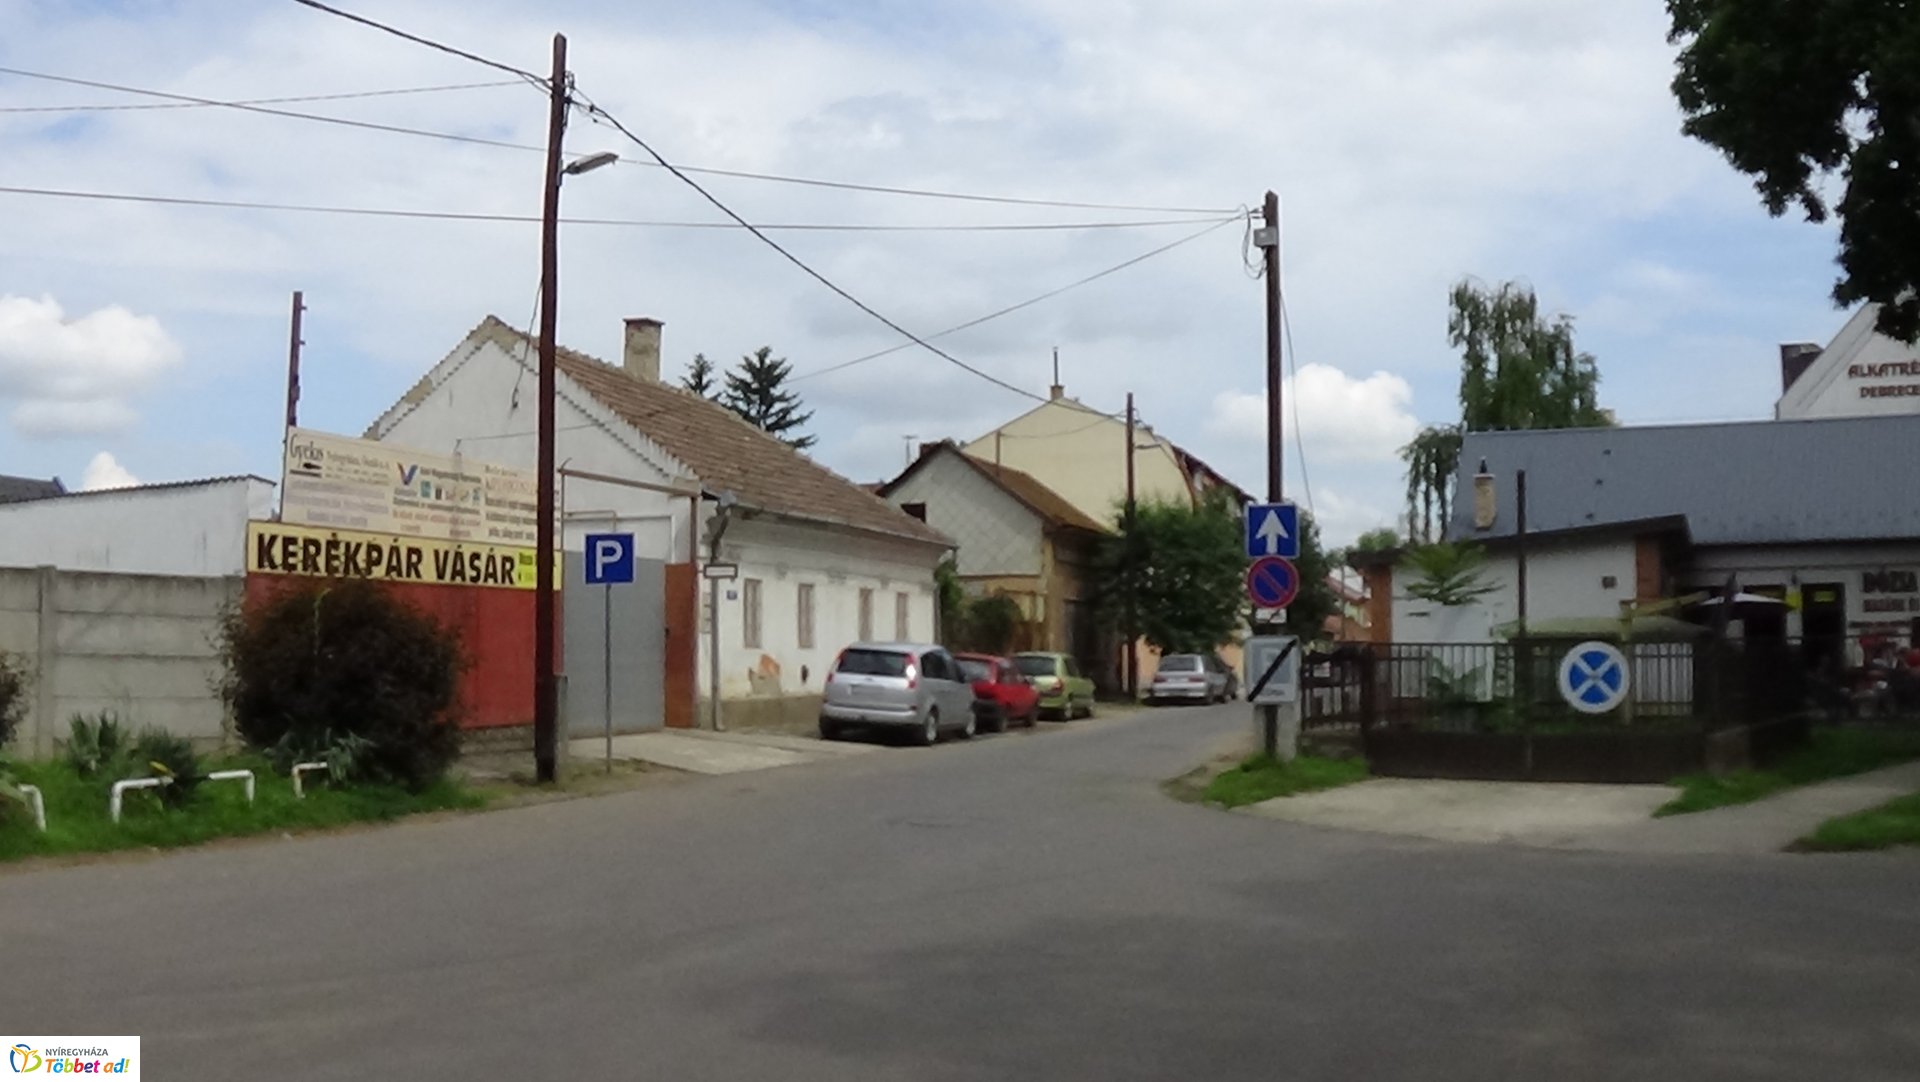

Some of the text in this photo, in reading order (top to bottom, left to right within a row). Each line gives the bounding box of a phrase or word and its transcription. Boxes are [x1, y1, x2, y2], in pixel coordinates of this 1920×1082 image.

[257, 532, 515, 585] KERÉKPÁR VÁSÁR
[595, 540, 623, 579] P
